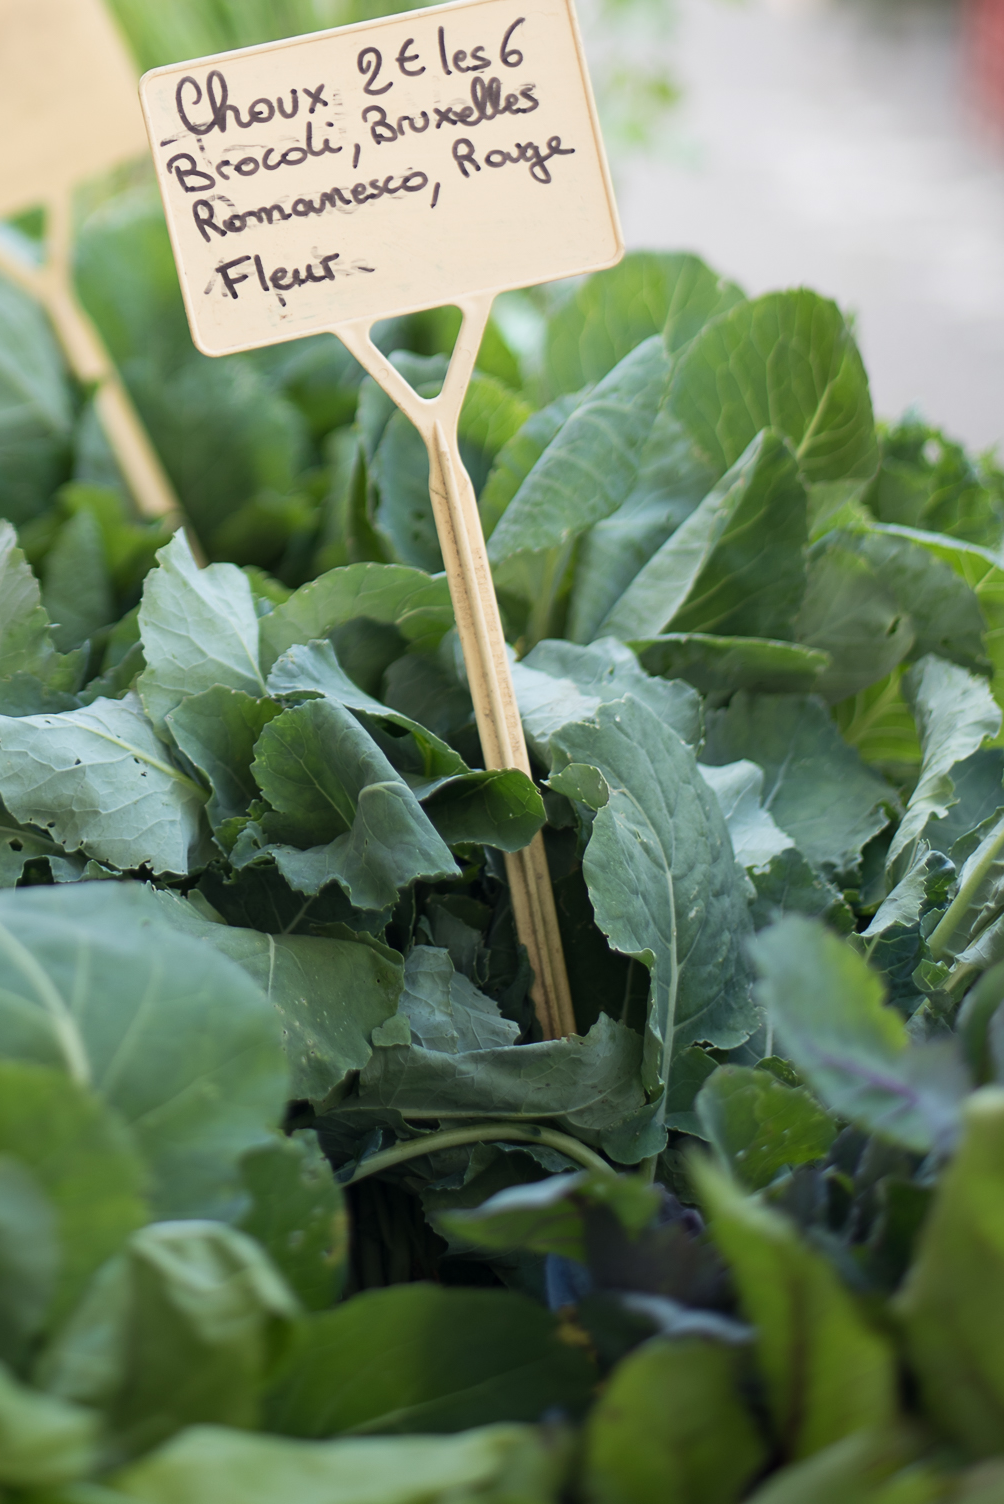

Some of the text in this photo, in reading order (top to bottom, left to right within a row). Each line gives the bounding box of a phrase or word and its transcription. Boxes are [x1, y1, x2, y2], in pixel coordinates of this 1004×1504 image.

[175, 70, 329, 136] Choux
[437, 25, 492, 76] les
[499, 16, 526, 68] 6
[361, 75, 540, 146] Bruxelles
[192, 135, 576, 244] Romanesco, Rouge
